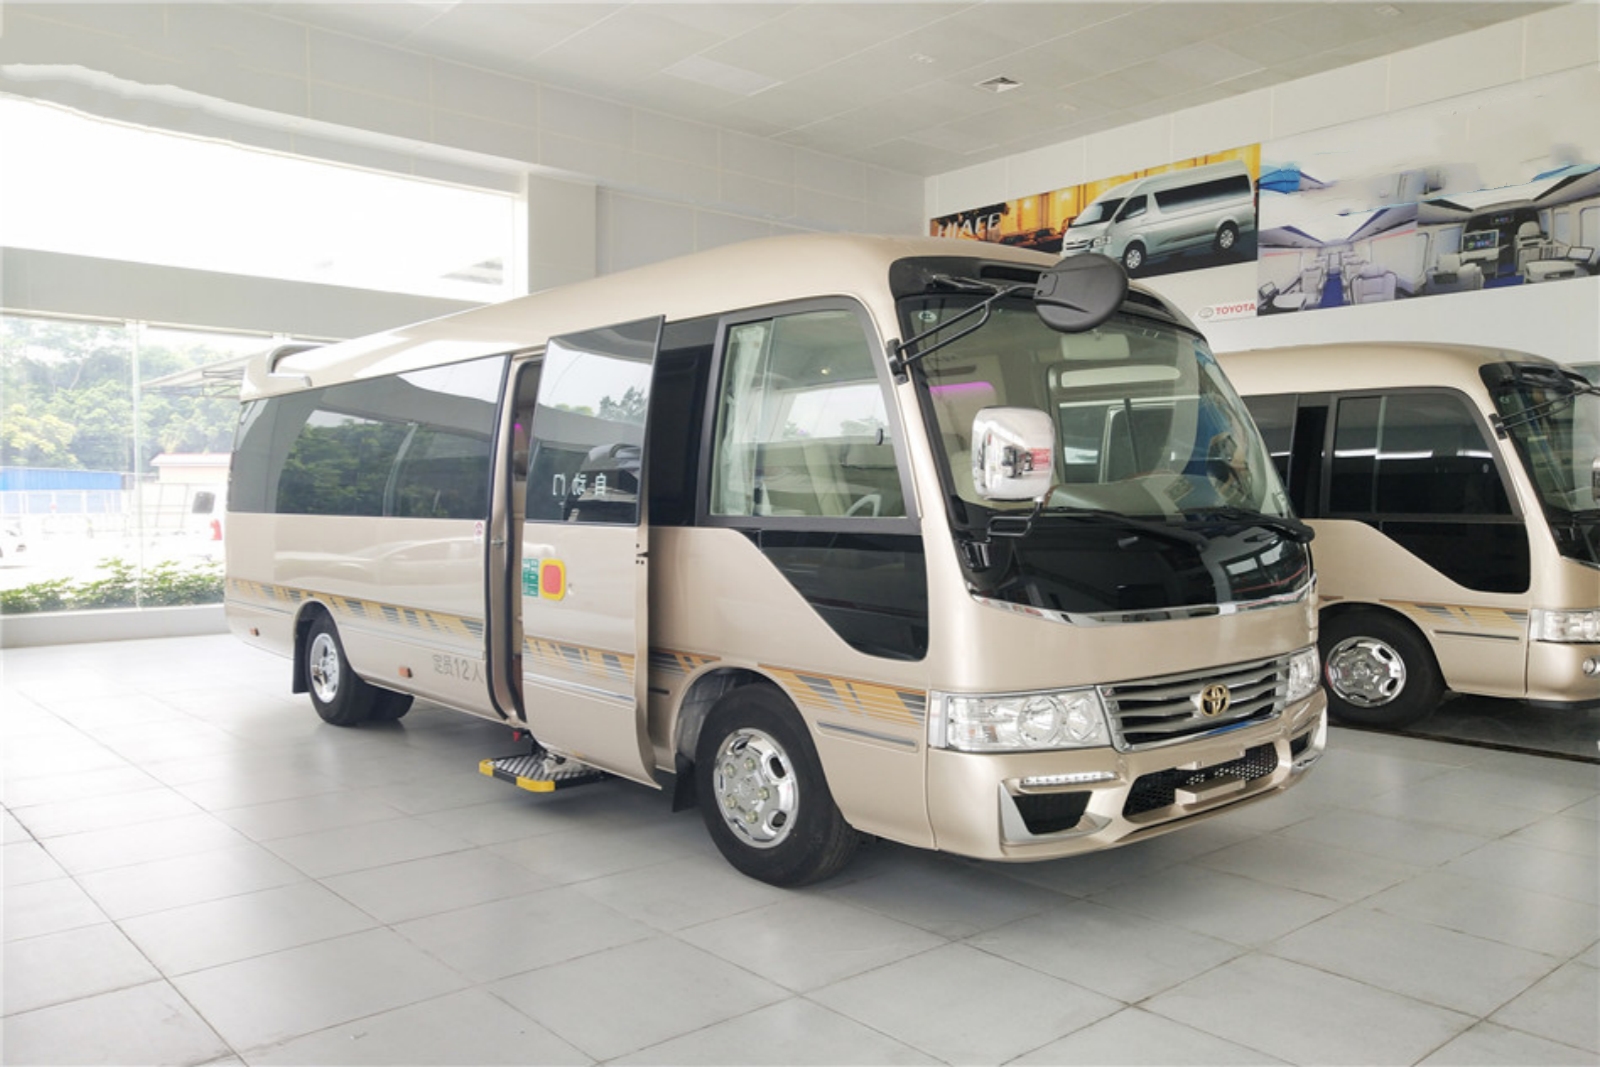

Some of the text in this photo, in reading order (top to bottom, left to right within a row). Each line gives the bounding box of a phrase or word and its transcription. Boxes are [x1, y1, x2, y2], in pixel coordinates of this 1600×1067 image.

[1215, 302, 1256, 315] TOYOTA
[432, 653, 485, 684] 定员12人
